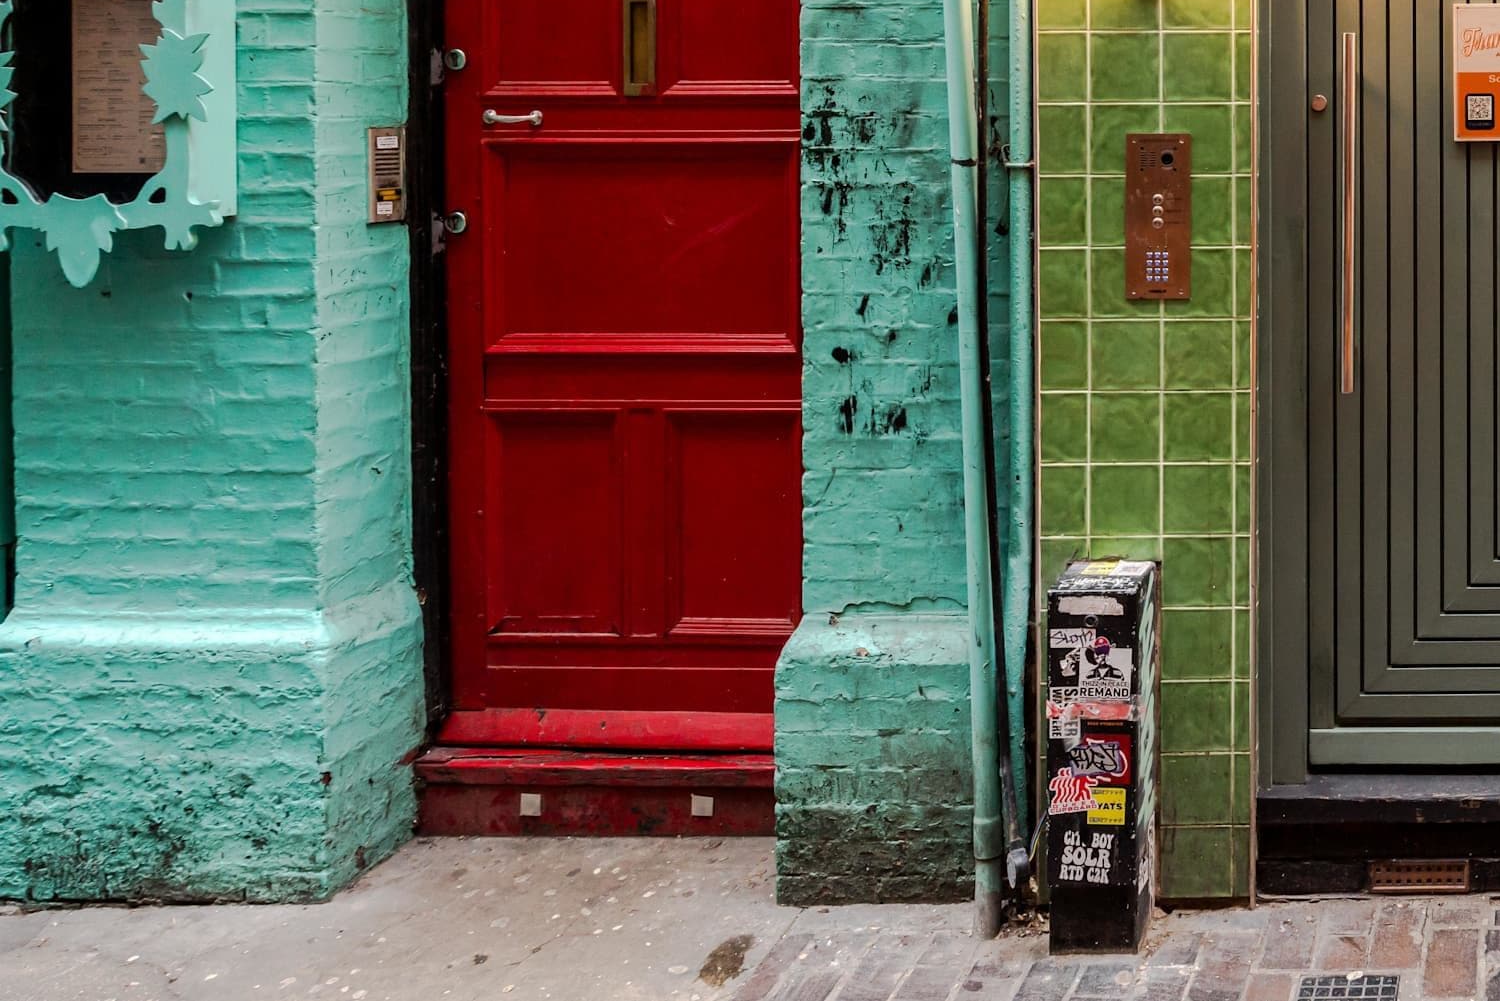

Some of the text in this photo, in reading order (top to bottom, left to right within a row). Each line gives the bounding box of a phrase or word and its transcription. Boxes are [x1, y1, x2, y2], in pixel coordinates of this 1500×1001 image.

[1080, 687, 1129, 697] REMAND
[1091, 833, 1114, 850] BOY
[1061, 845, 1111, 868] SOLR
[1059, 864, 1110, 884] RTD C2K
